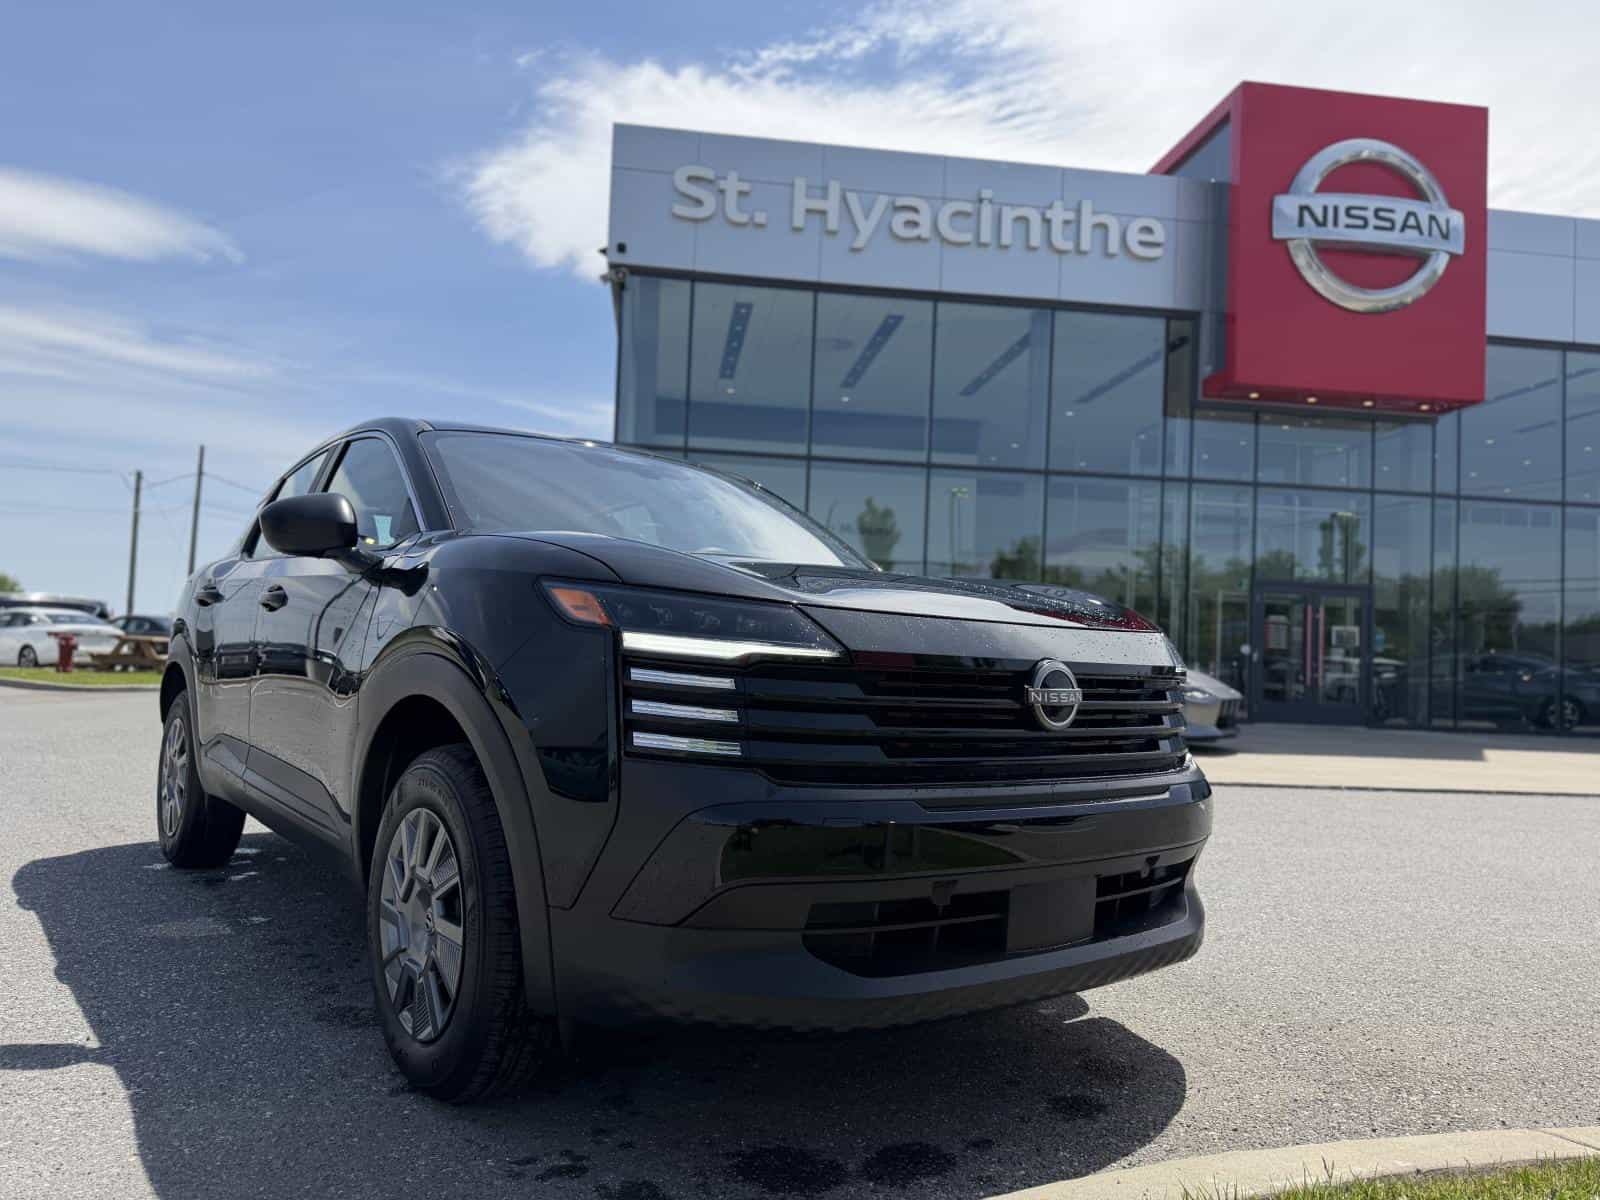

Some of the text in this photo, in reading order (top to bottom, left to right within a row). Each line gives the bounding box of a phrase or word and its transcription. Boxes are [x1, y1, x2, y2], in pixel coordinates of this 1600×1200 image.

[671, 164, 1167, 260] St. Hyacinthe
[1297, 204, 1450, 241] NISSAN
[1031, 691, 1082, 703] NISSAN
